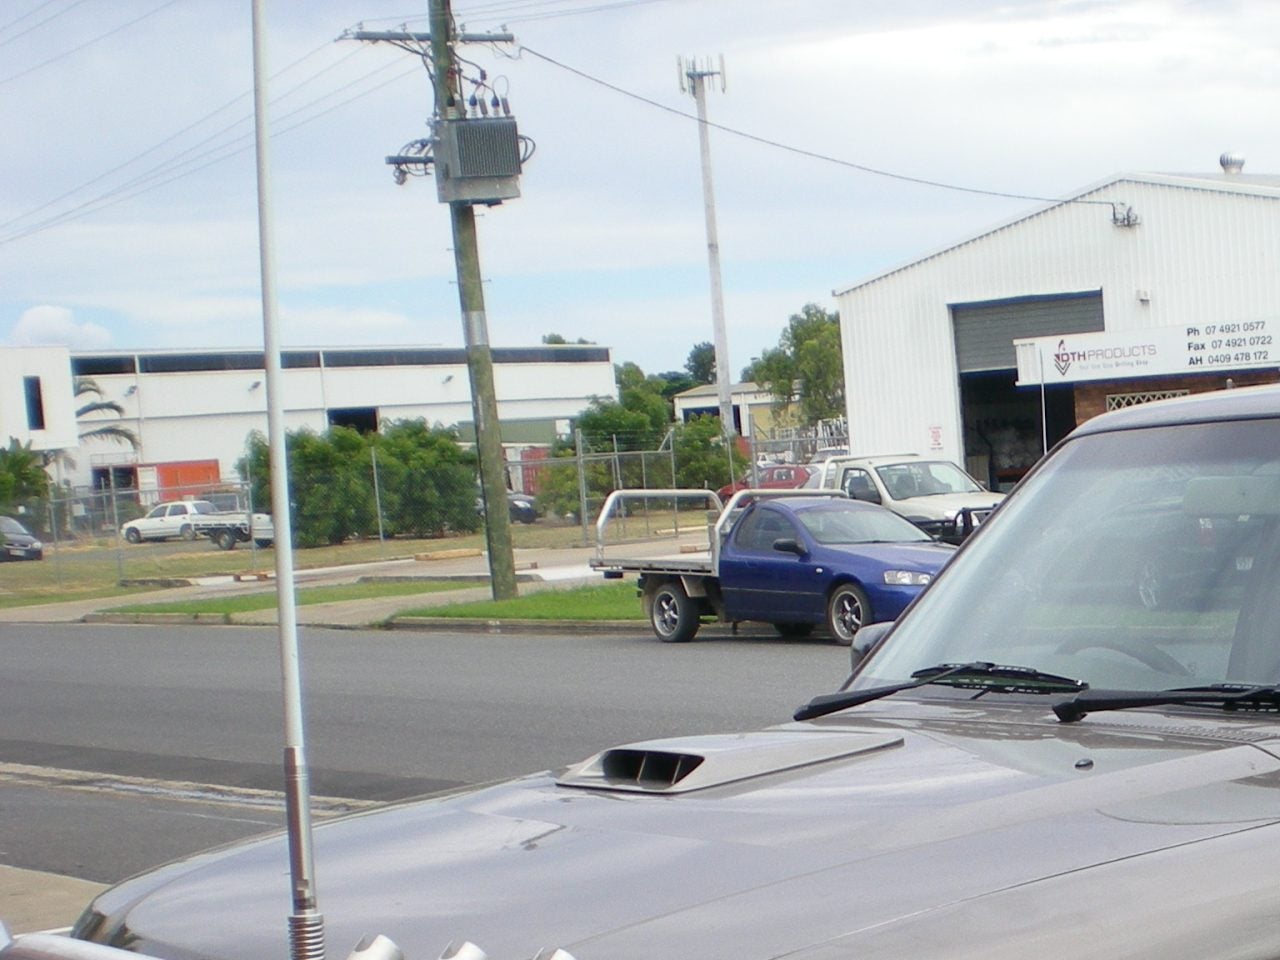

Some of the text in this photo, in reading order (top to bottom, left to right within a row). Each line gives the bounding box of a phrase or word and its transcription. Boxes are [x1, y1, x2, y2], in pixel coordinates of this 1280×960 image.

[1187, 321, 1266, 336] Ph 07 4921 0577
[1188, 336, 1272, 351] Fax 07 4921 0722
[1087, 344, 1157, 361] PRODUCTS
[1188, 350, 1268, 365] AH 0409 478 172
